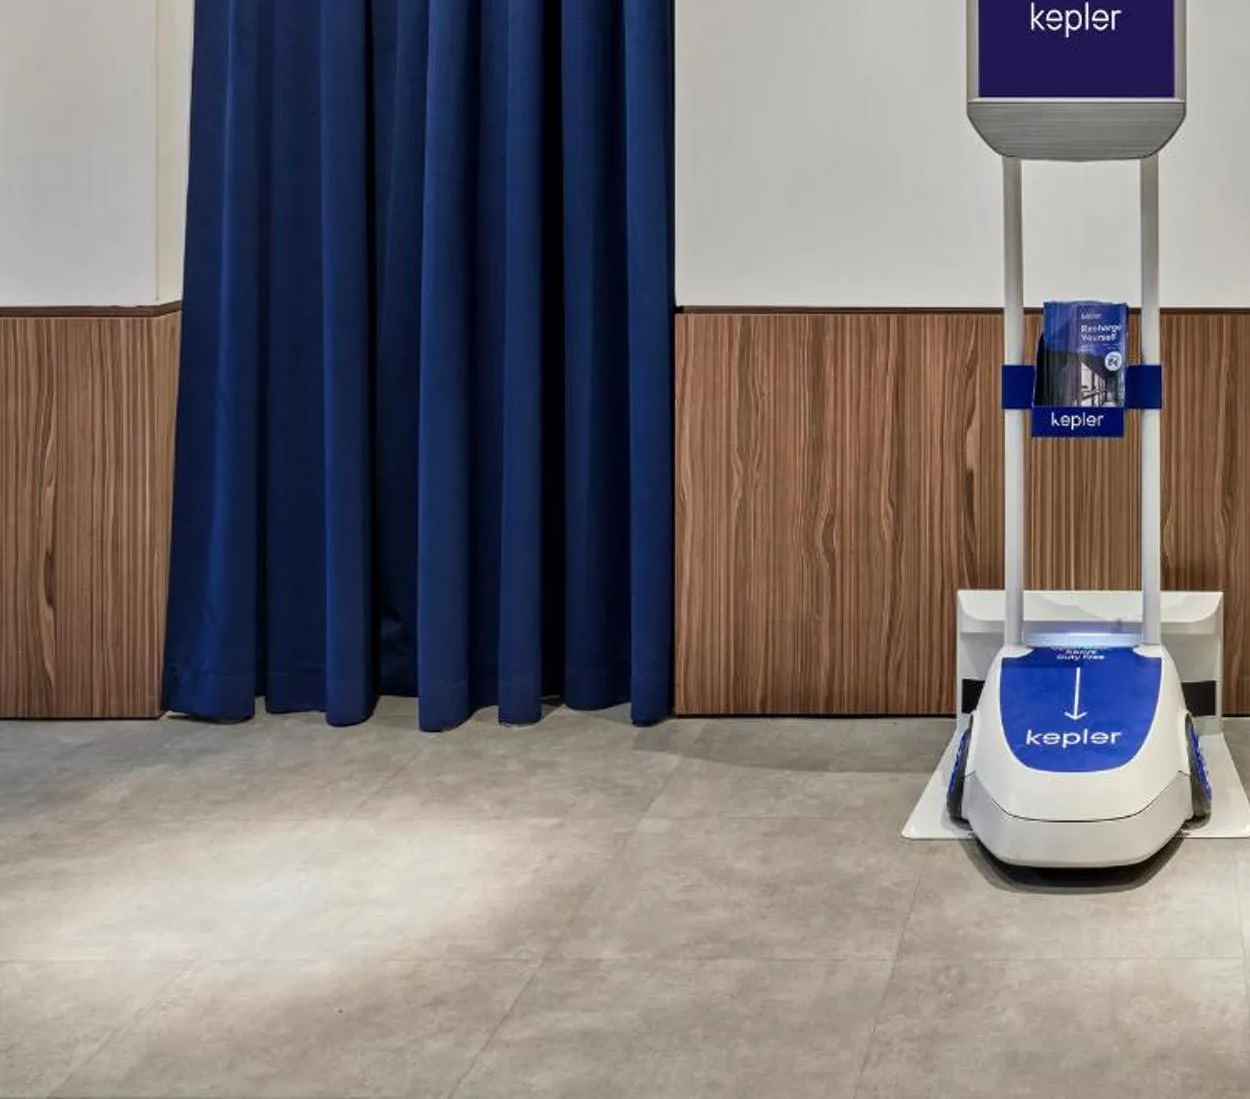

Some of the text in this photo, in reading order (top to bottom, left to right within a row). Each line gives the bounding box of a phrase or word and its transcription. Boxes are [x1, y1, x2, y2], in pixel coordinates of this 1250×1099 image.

[1030, 1, 1121, 38] kepler
[1051, 412, 1105, 430] kepler
[1026, 729, 1122, 748] kepler
